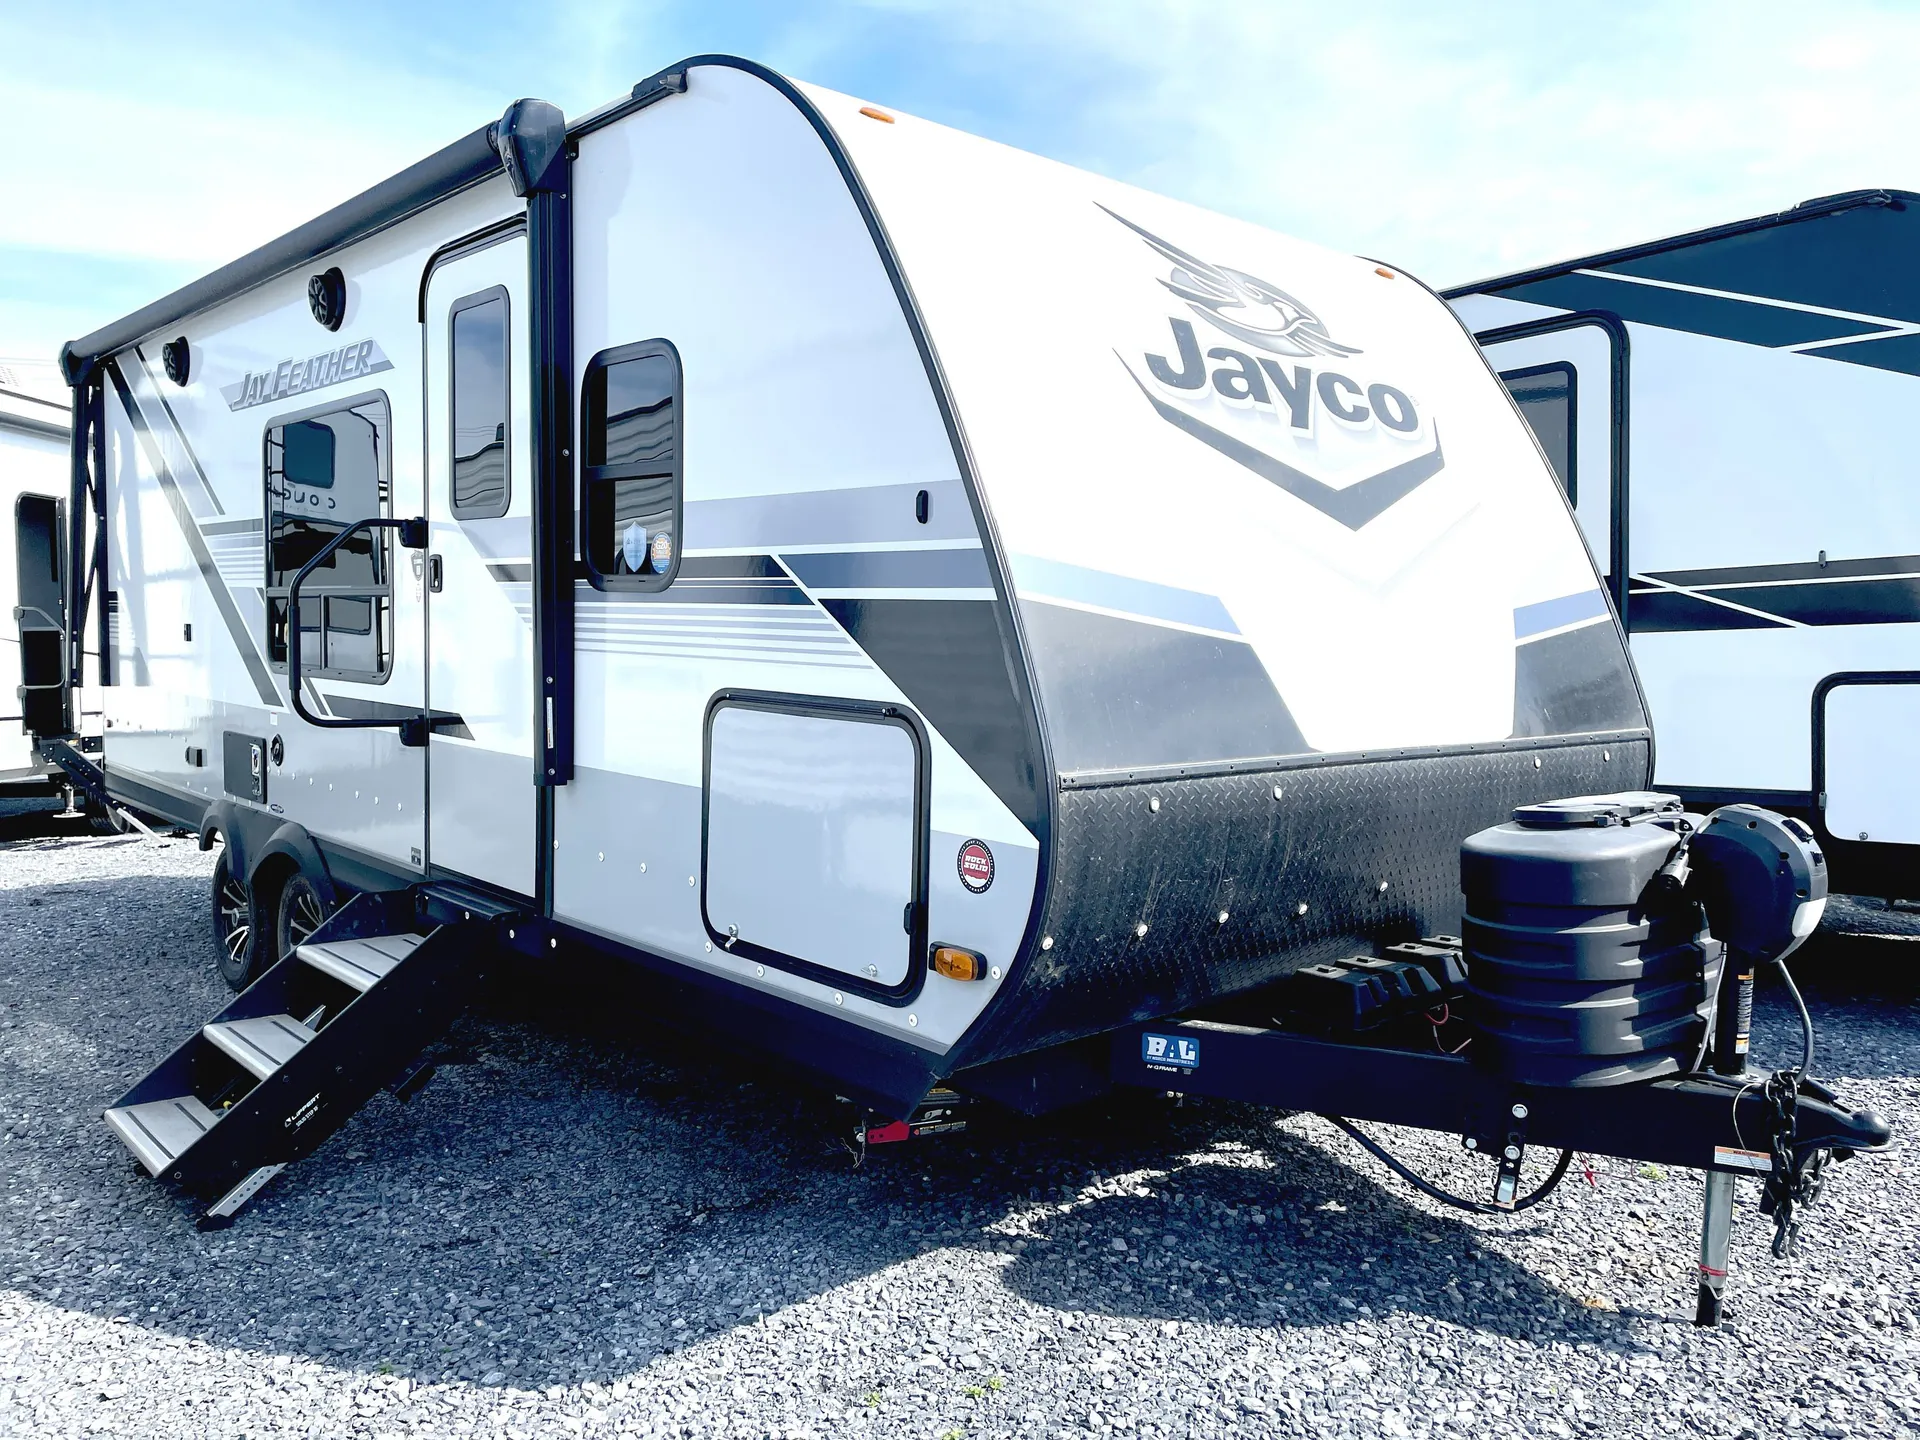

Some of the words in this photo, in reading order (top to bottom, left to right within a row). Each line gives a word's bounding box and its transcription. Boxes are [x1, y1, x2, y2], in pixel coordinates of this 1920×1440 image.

[231, 371, 271, 410] JAY
[271, 337, 374, 400] FEATHER
[1144, 316, 1419, 433] Jayco
[964, 861, 989, 872] SOLID
[965, 854, 987, 865] ROCK
[1147, 1036, 1196, 1061] BAL
[291, 1092, 321, 1121] LIPPERT
